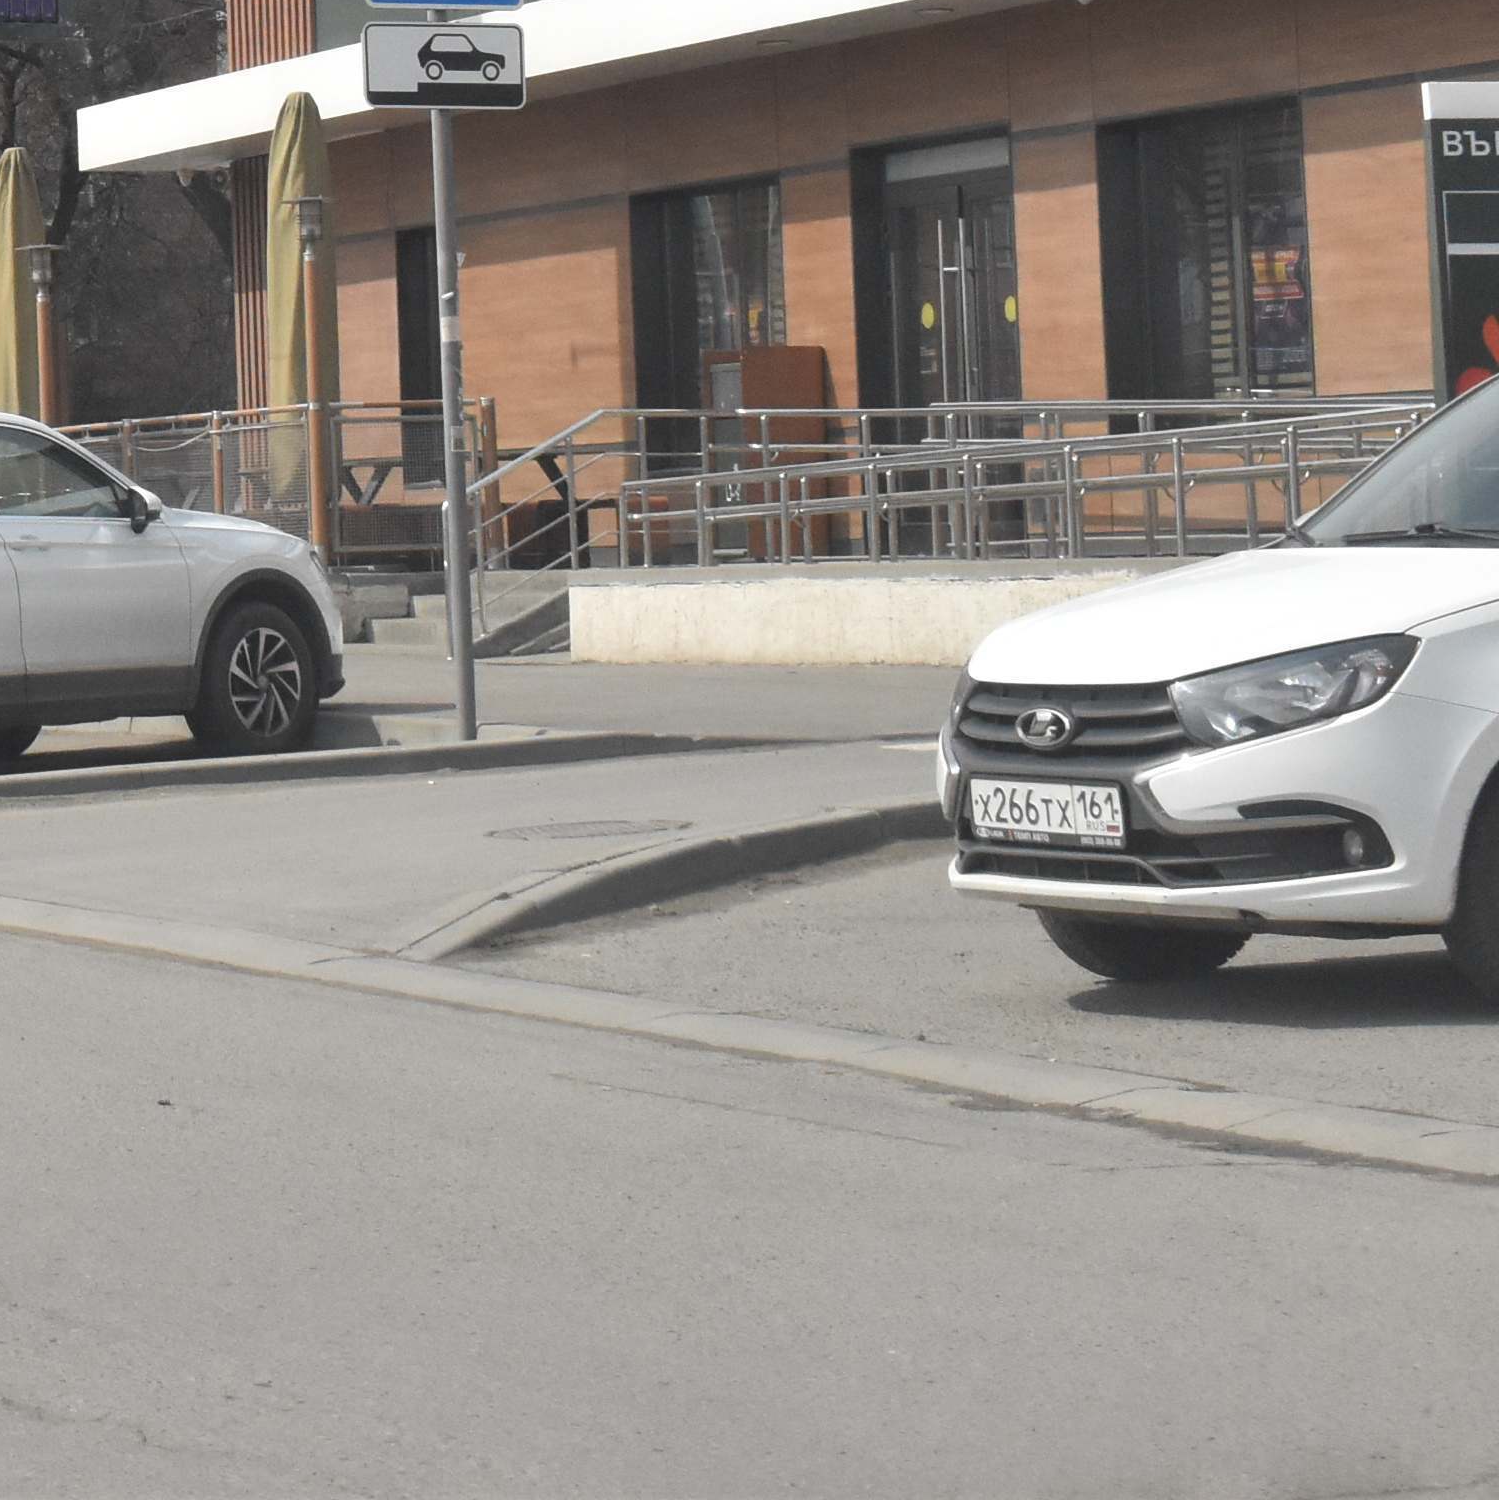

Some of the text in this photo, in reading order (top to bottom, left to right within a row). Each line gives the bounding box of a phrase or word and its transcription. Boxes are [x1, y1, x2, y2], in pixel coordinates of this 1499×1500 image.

[1442, 130, 1499, 156] ВЪ
[978, 786, 1116, 829] Х266ТХ 161
